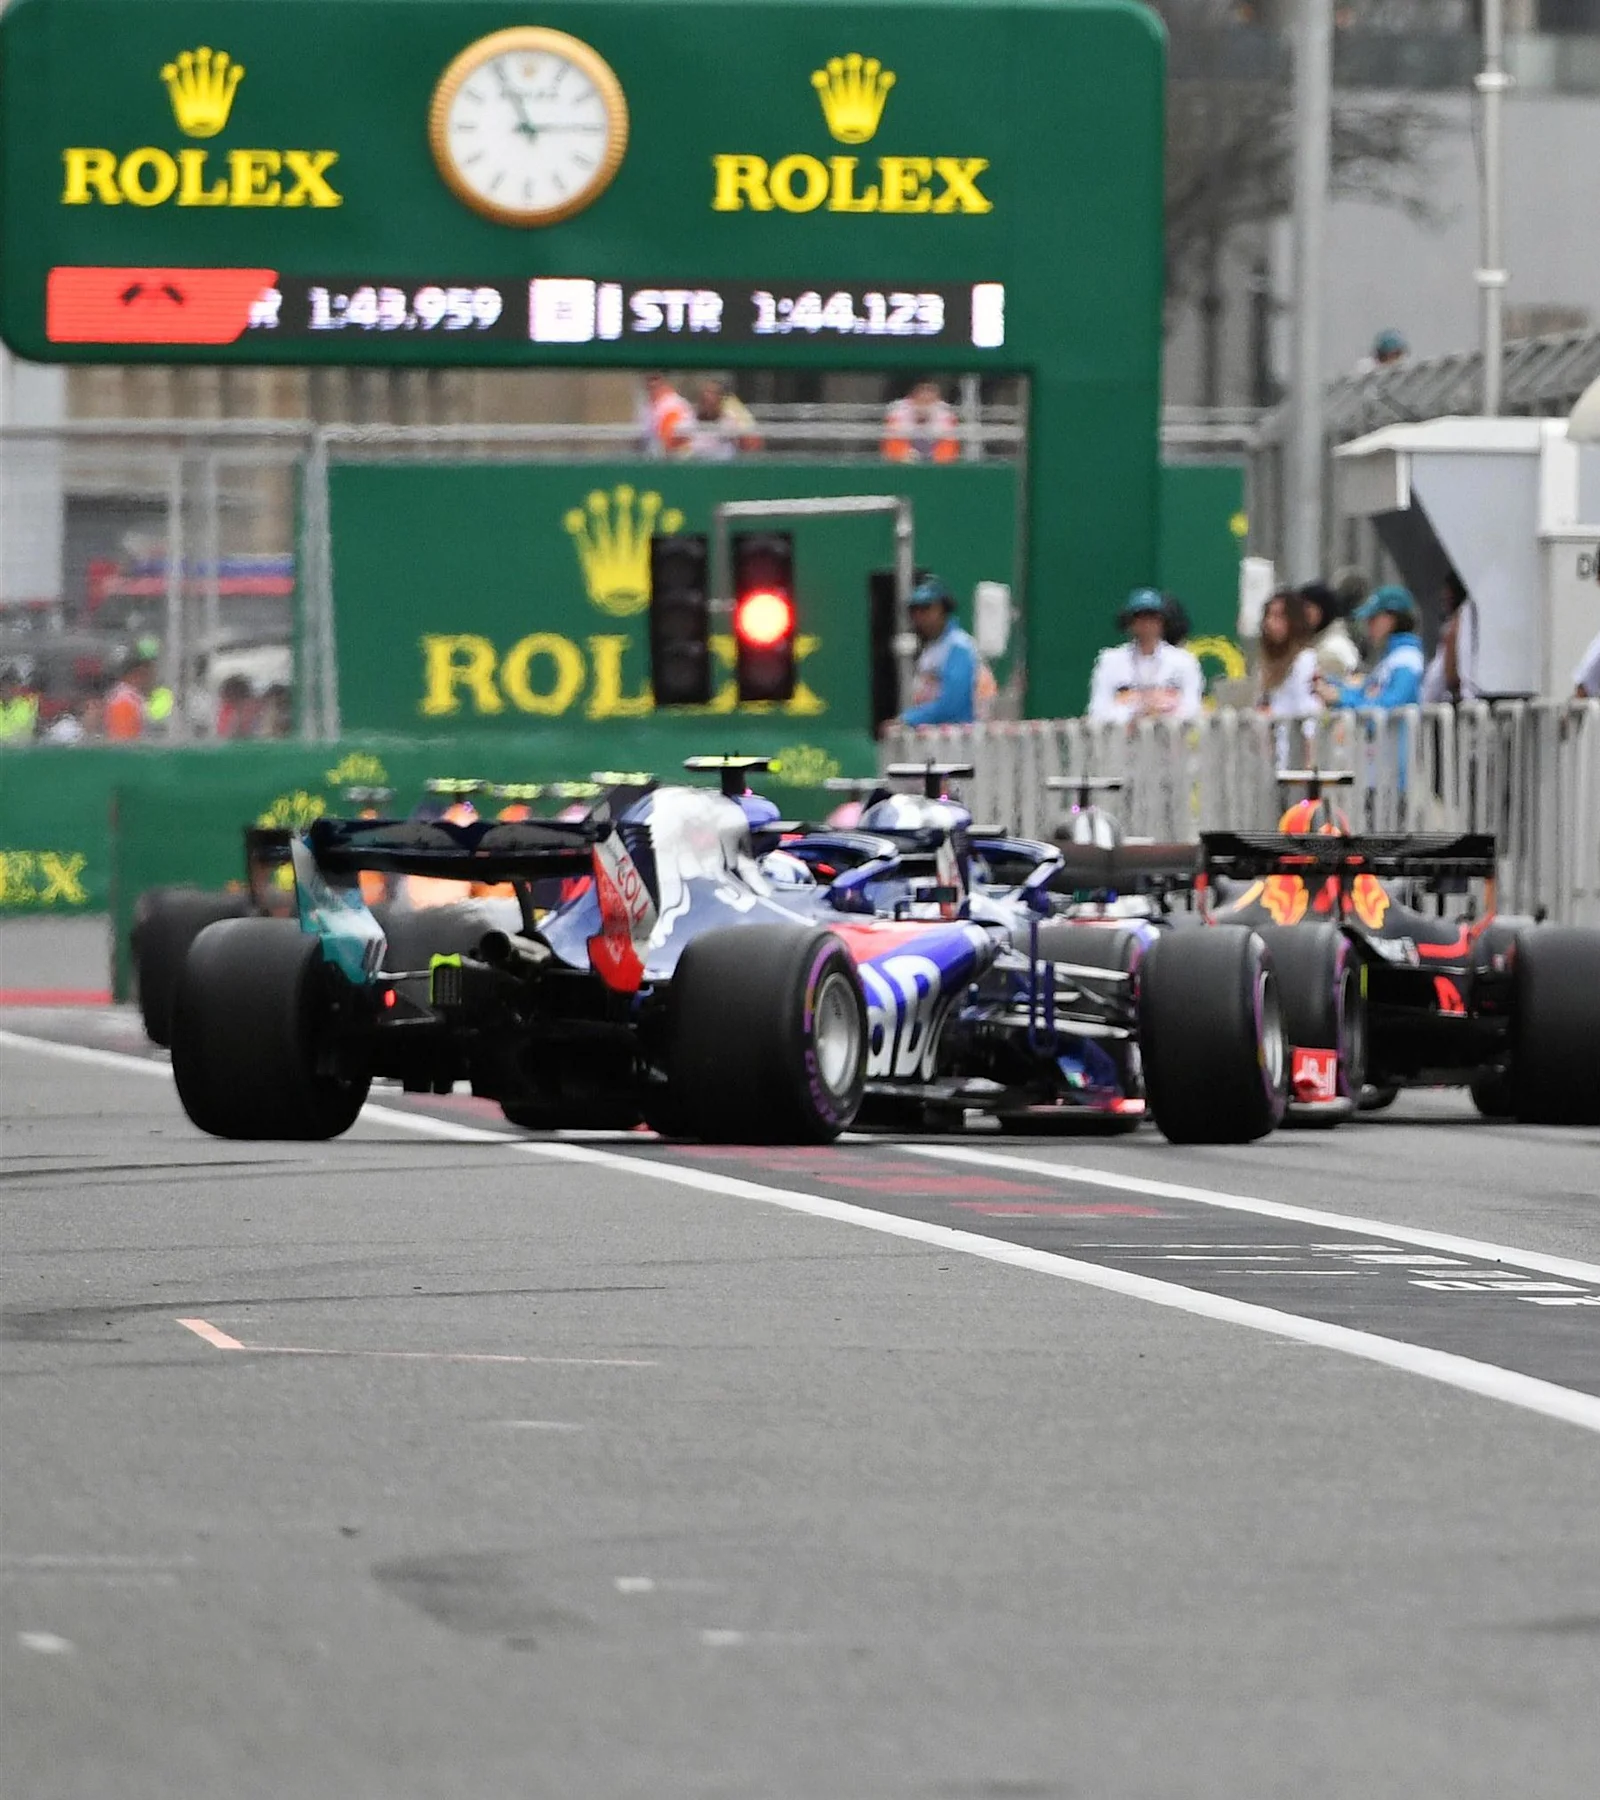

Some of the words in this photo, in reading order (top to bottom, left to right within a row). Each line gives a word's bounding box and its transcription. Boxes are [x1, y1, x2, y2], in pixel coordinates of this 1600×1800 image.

[61, 147, 342, 208] ROLEX
[711, 154, 993, 214] ROLEX
[308, 285, 502, 331] 1:43.959
[630, 289, 724, 334] STR
[752, 289, 945, 335] 1:44.123
